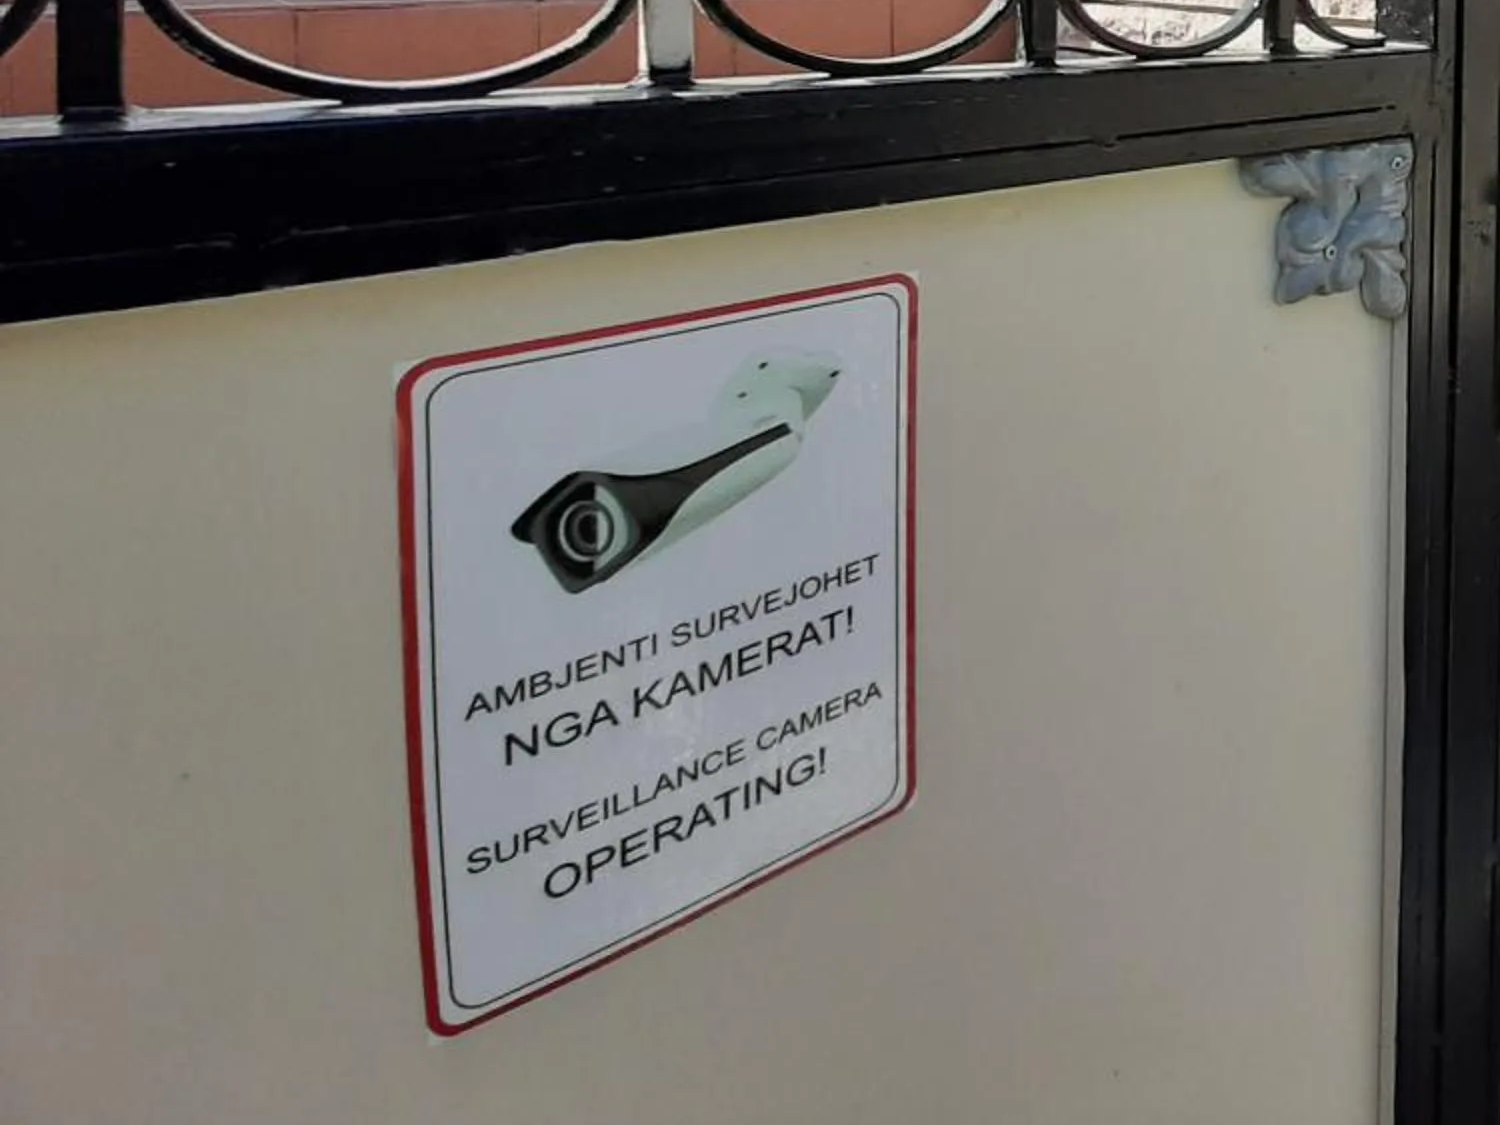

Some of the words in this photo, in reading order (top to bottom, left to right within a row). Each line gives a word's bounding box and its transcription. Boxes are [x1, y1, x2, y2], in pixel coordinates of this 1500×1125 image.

[464, 632, 658, 723] AMBJENTI
[670, 553, 881, 648] SURVEJOHET
[503, 699, 621, 767] NGA
[632, 605, 854, 719] KAMERAT!
[466, 738, 746, 875] SURVEILLANCE
[755, 681, 883, 752] CAMERA
[543, 746, 827, 900] OPERATING!
